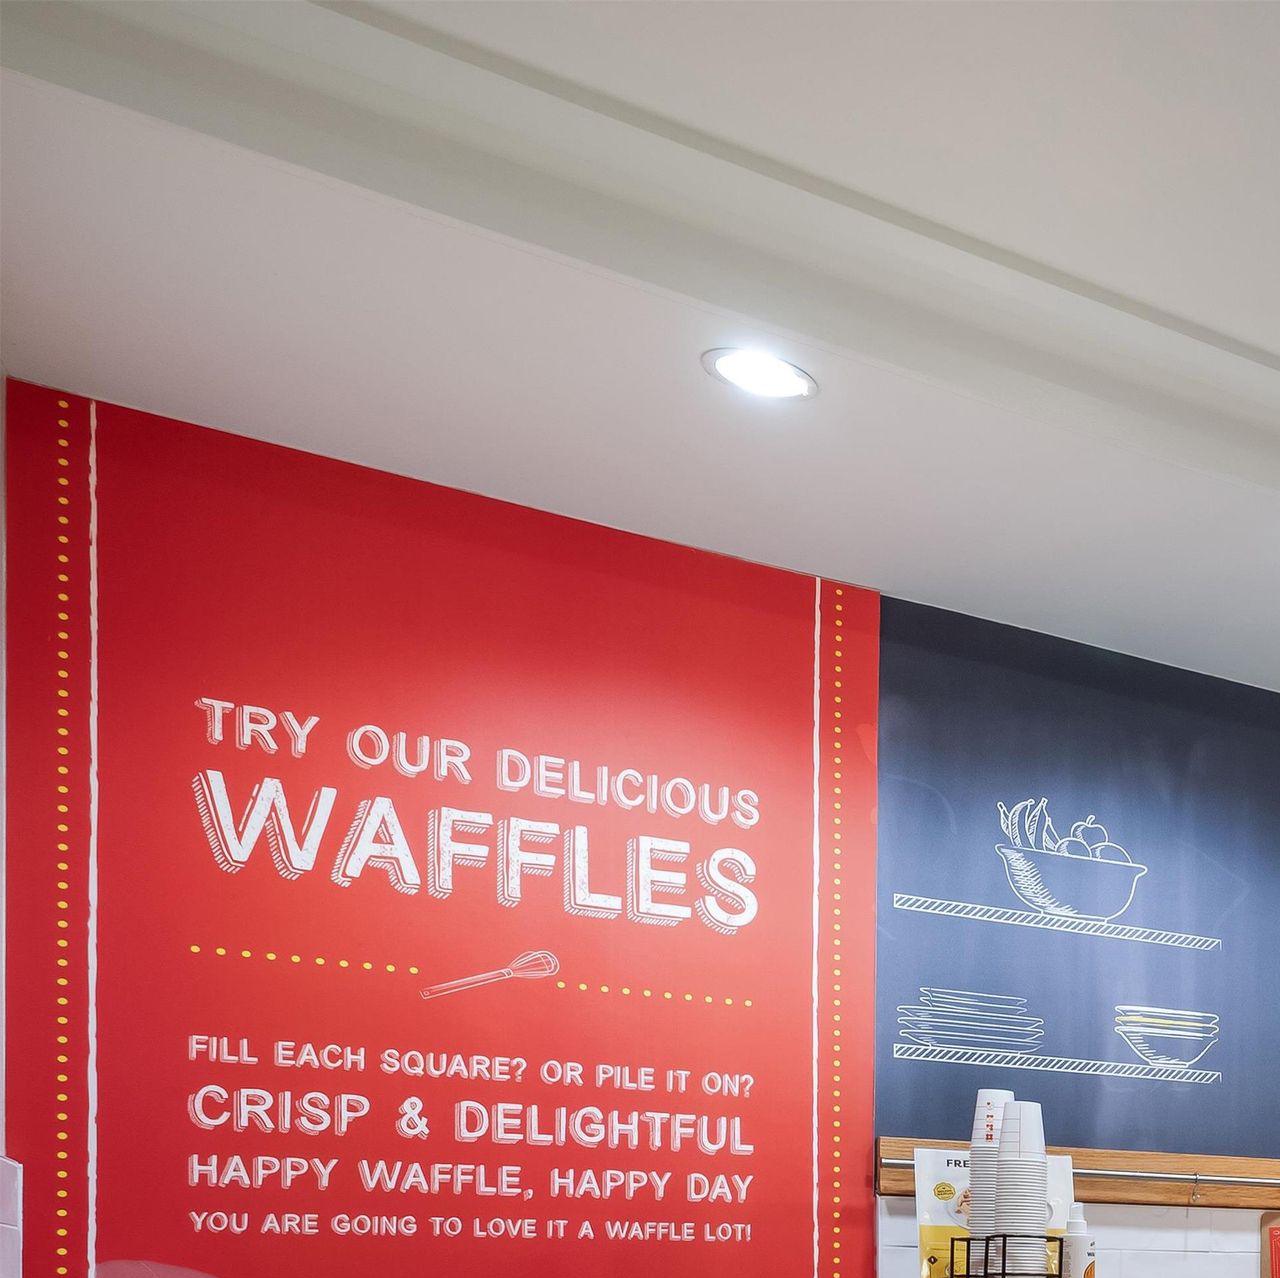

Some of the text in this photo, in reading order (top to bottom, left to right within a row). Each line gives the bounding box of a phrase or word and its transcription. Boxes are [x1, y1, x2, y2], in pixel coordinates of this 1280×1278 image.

[194, 697, 760, 829] TRY OUR DELICIOUS
[191, 769, 760, 935] WAFFLES
[188, 1034, 755, 1098] FILL EACH SQUARE? OR PILE IT ON?
[187, 1084, 755, 1156] CRISP & DELIGHTFUL
[188, 1154, 754, 1204] HAPPY WAFFLE, HAPPY DAY
[946, 1159, 970, 1168] FRE
[188, 1211, 752, 1242] YOU ARE GOING TO LOVE IT A WAFFLE LOT!
